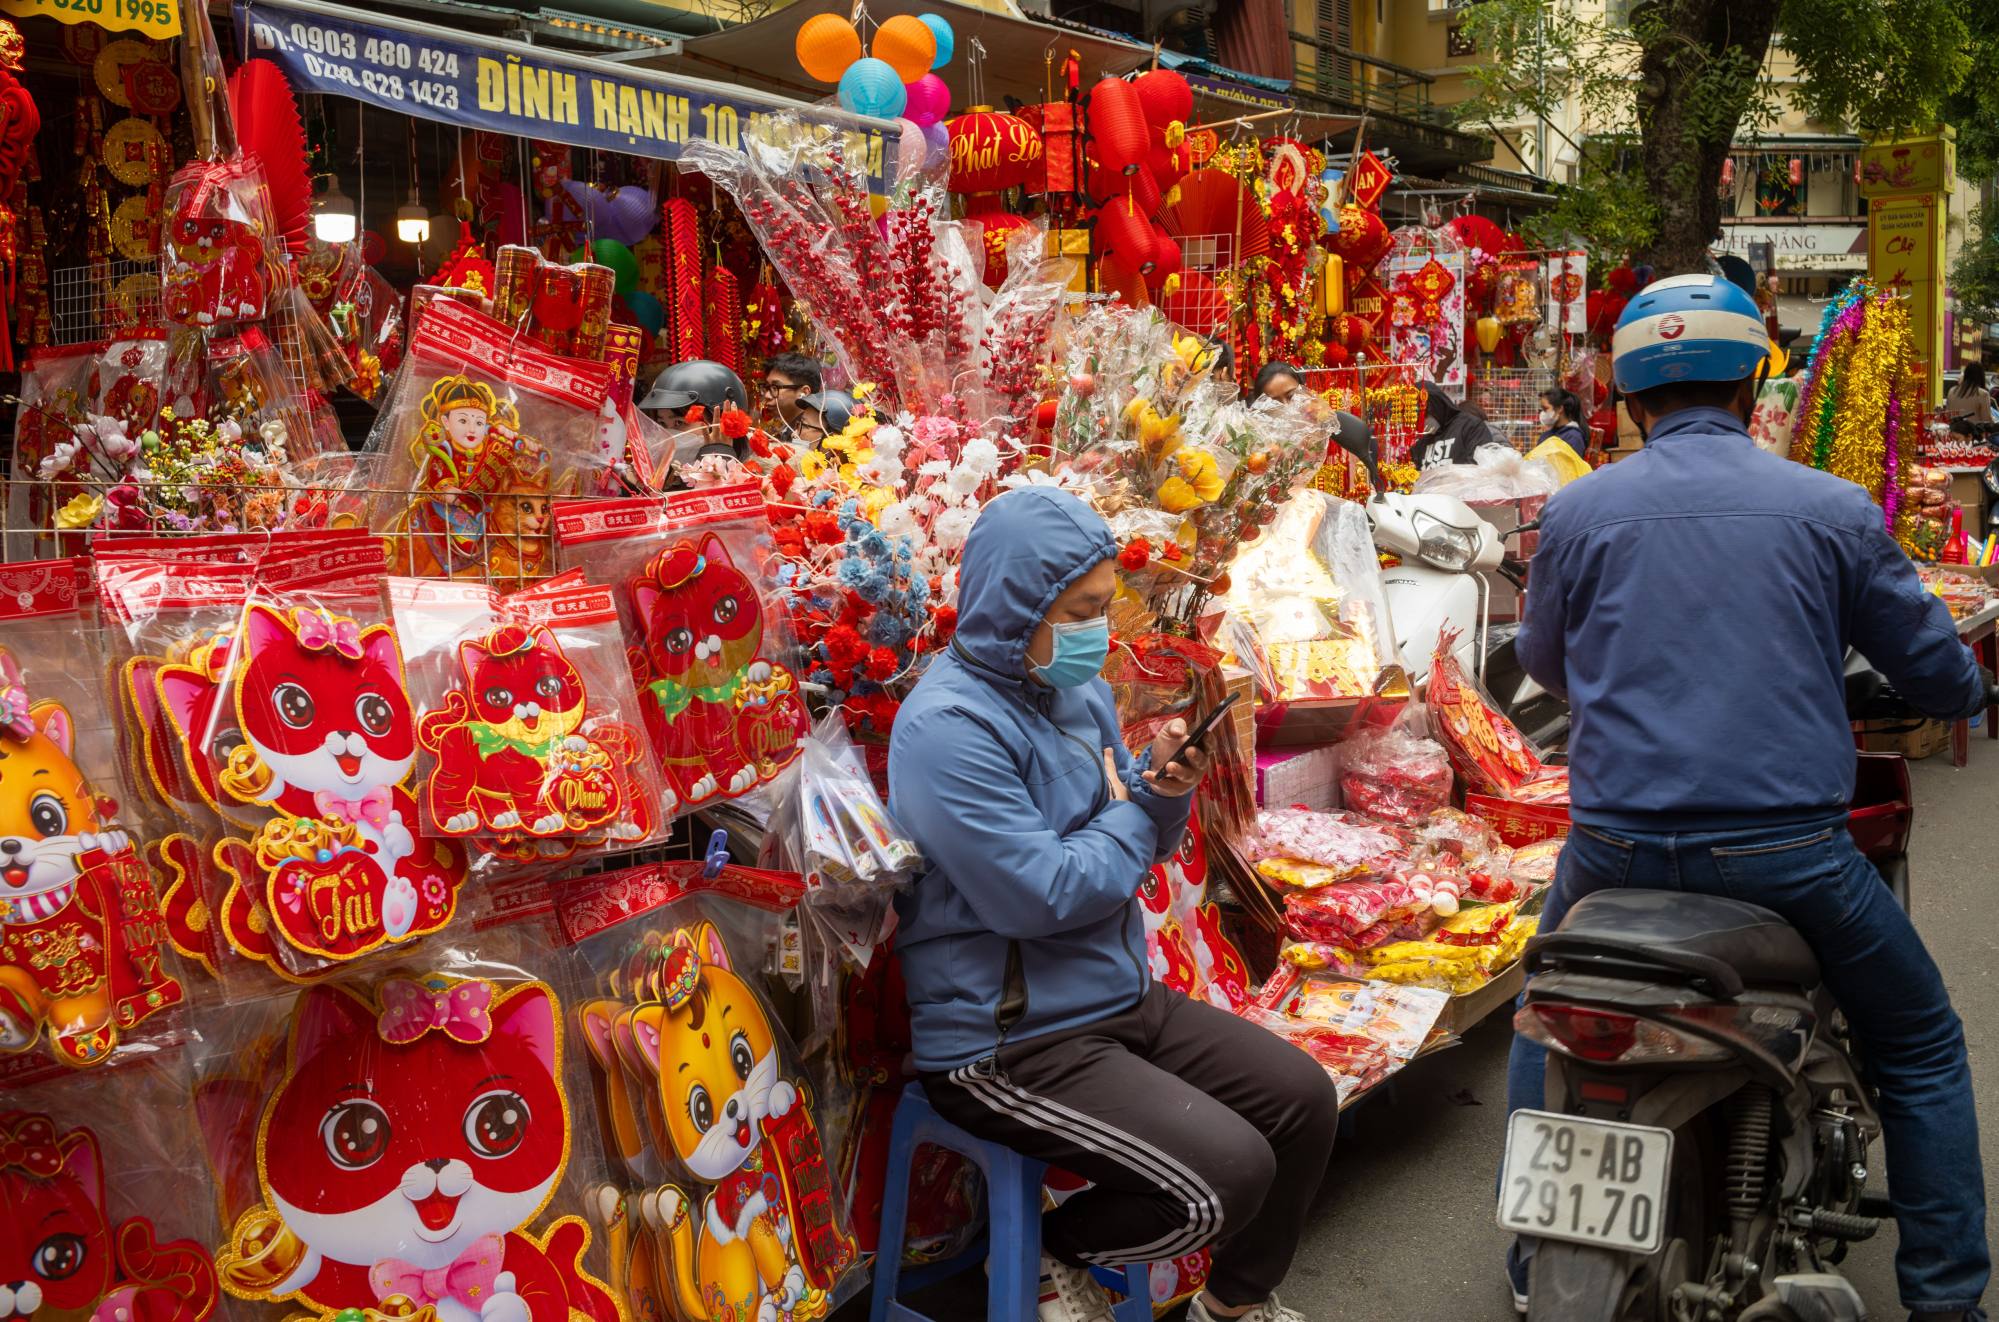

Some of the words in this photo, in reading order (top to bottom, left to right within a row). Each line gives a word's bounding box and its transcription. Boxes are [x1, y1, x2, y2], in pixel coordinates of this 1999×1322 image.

[116, 0, 172, 25] 1995
[365, 38, 411, 69] 480
[418, 48, 460, 79] 424
[361, 70, 405, 100] 828
[409, 79, 460, 110] 1423
[477, 54, 580, 126] ĐĨNH
[591, 79, 690, 145] HẠNH
[701, 103, 740, 150] 10
[949, 131, 1002, 175] Phát
[310, 871, 380, 940] Tài
[1530, 1123, 1643, 1183] 29-AB
[1510, 1175, 1652, 1242] 291.70
